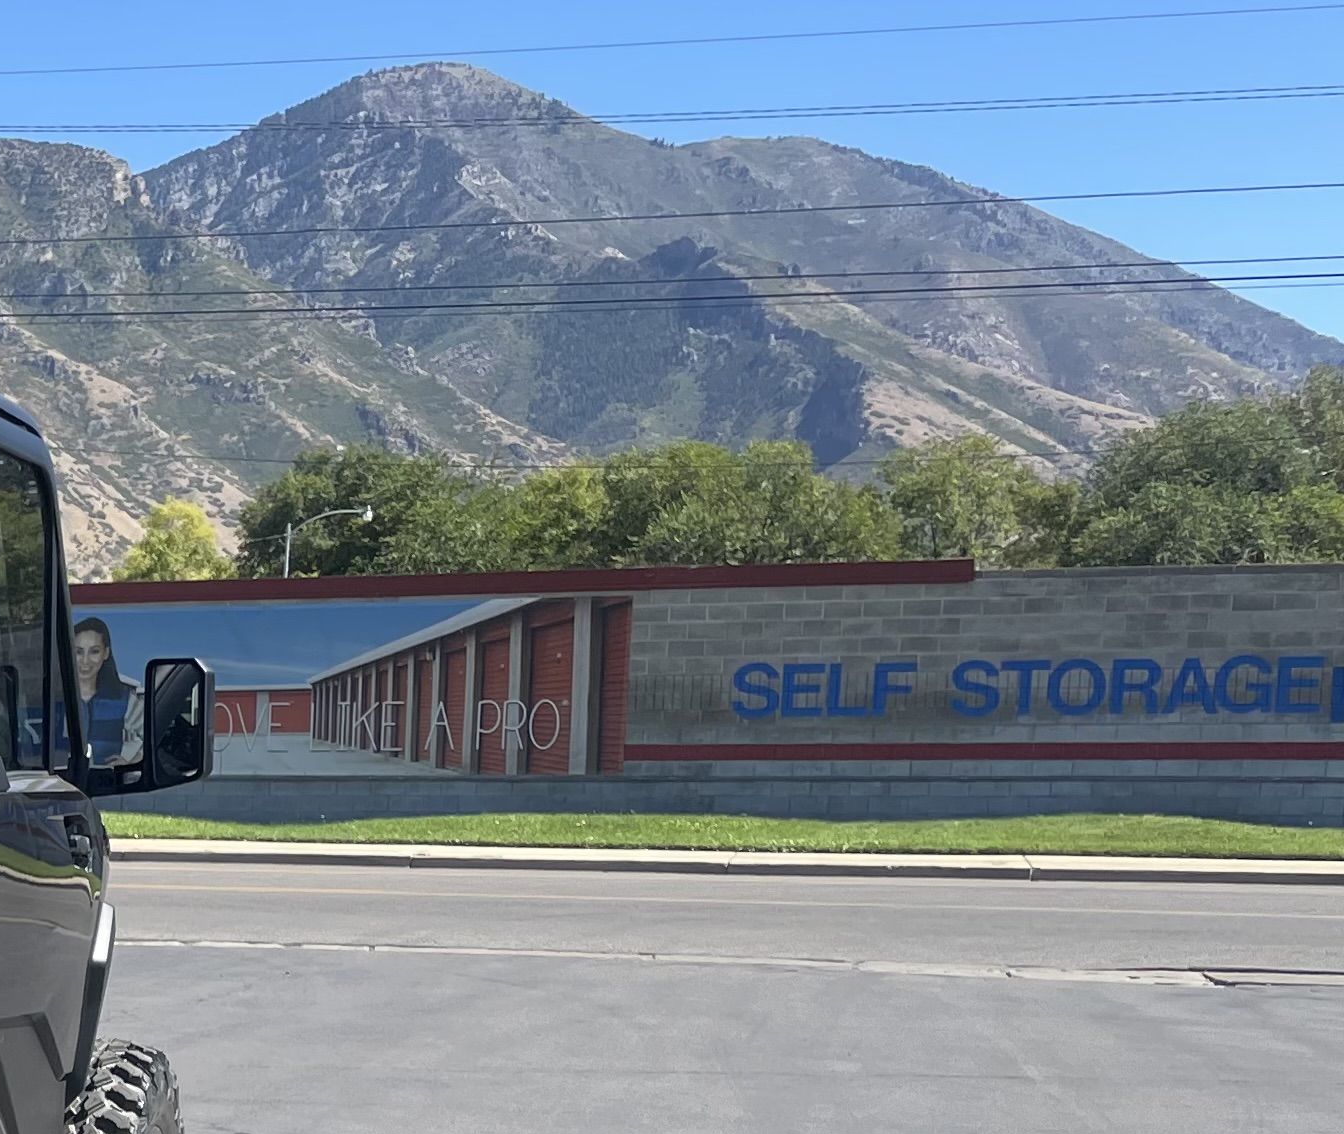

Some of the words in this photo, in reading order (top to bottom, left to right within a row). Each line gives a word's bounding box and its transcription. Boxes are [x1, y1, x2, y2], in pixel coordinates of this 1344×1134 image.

[731, 661, 917, 719] SELF
[950, 654, 1324, 717] STORAGE
[215, 701, 291, 753] OVE
[424, 700, 455, 751] A
[475, 699, 560, 750] PRO
